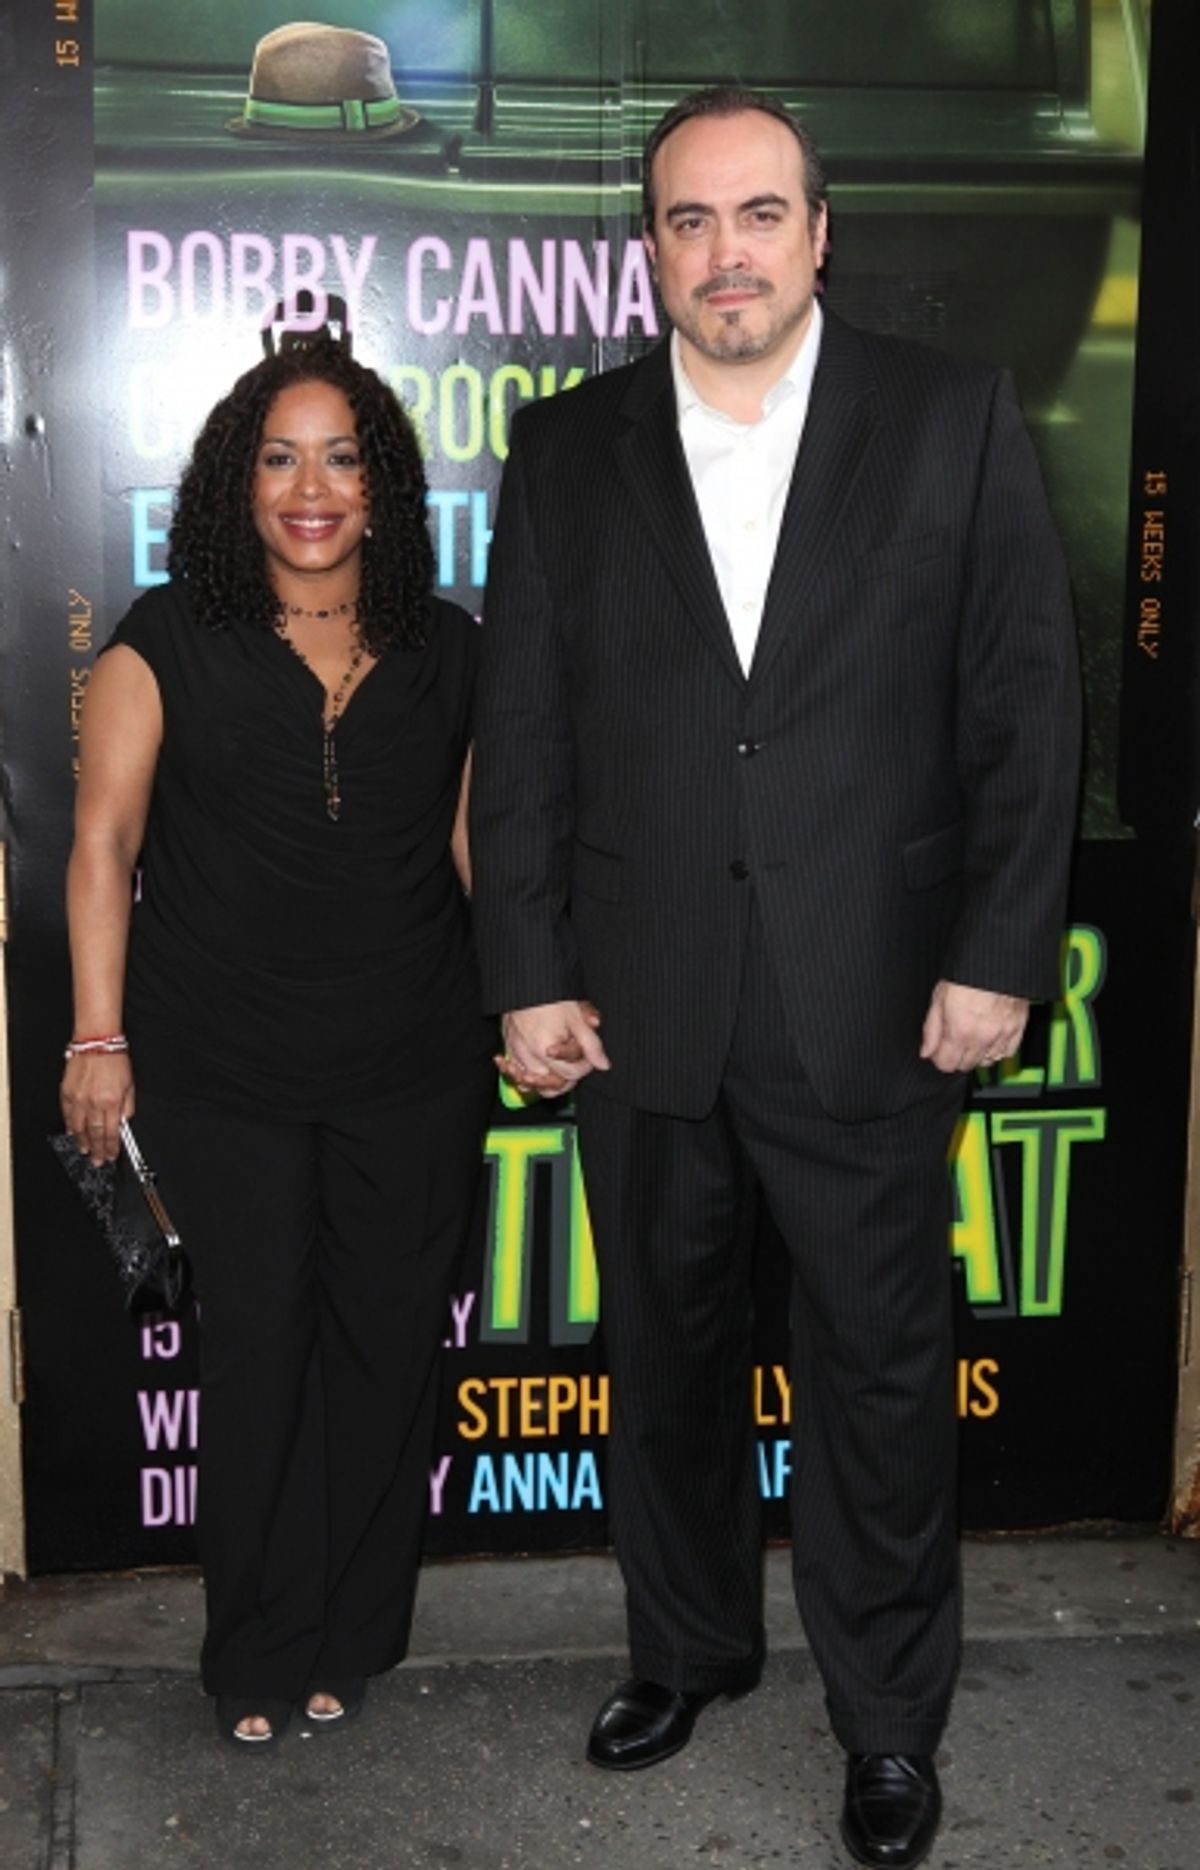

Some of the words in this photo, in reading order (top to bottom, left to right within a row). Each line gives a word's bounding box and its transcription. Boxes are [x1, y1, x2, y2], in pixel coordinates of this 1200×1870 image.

[56, 40, 79, 67] 15
[127, 230, 378, 332] BOBBY
[407, 236, 659, 337] CANNA
[1145, 470, 1167, 495] 15
[1140, 510, 1164, 582] WEEKS
[69, 587, 92, 651] ONLY
[1137, 598, 1161, 659] ONLY
[948, 1107, 1106, 1319] AT
[457, 1374, 610, 1440] STEPH
[467, 1451, 604, 1513] ANNA
